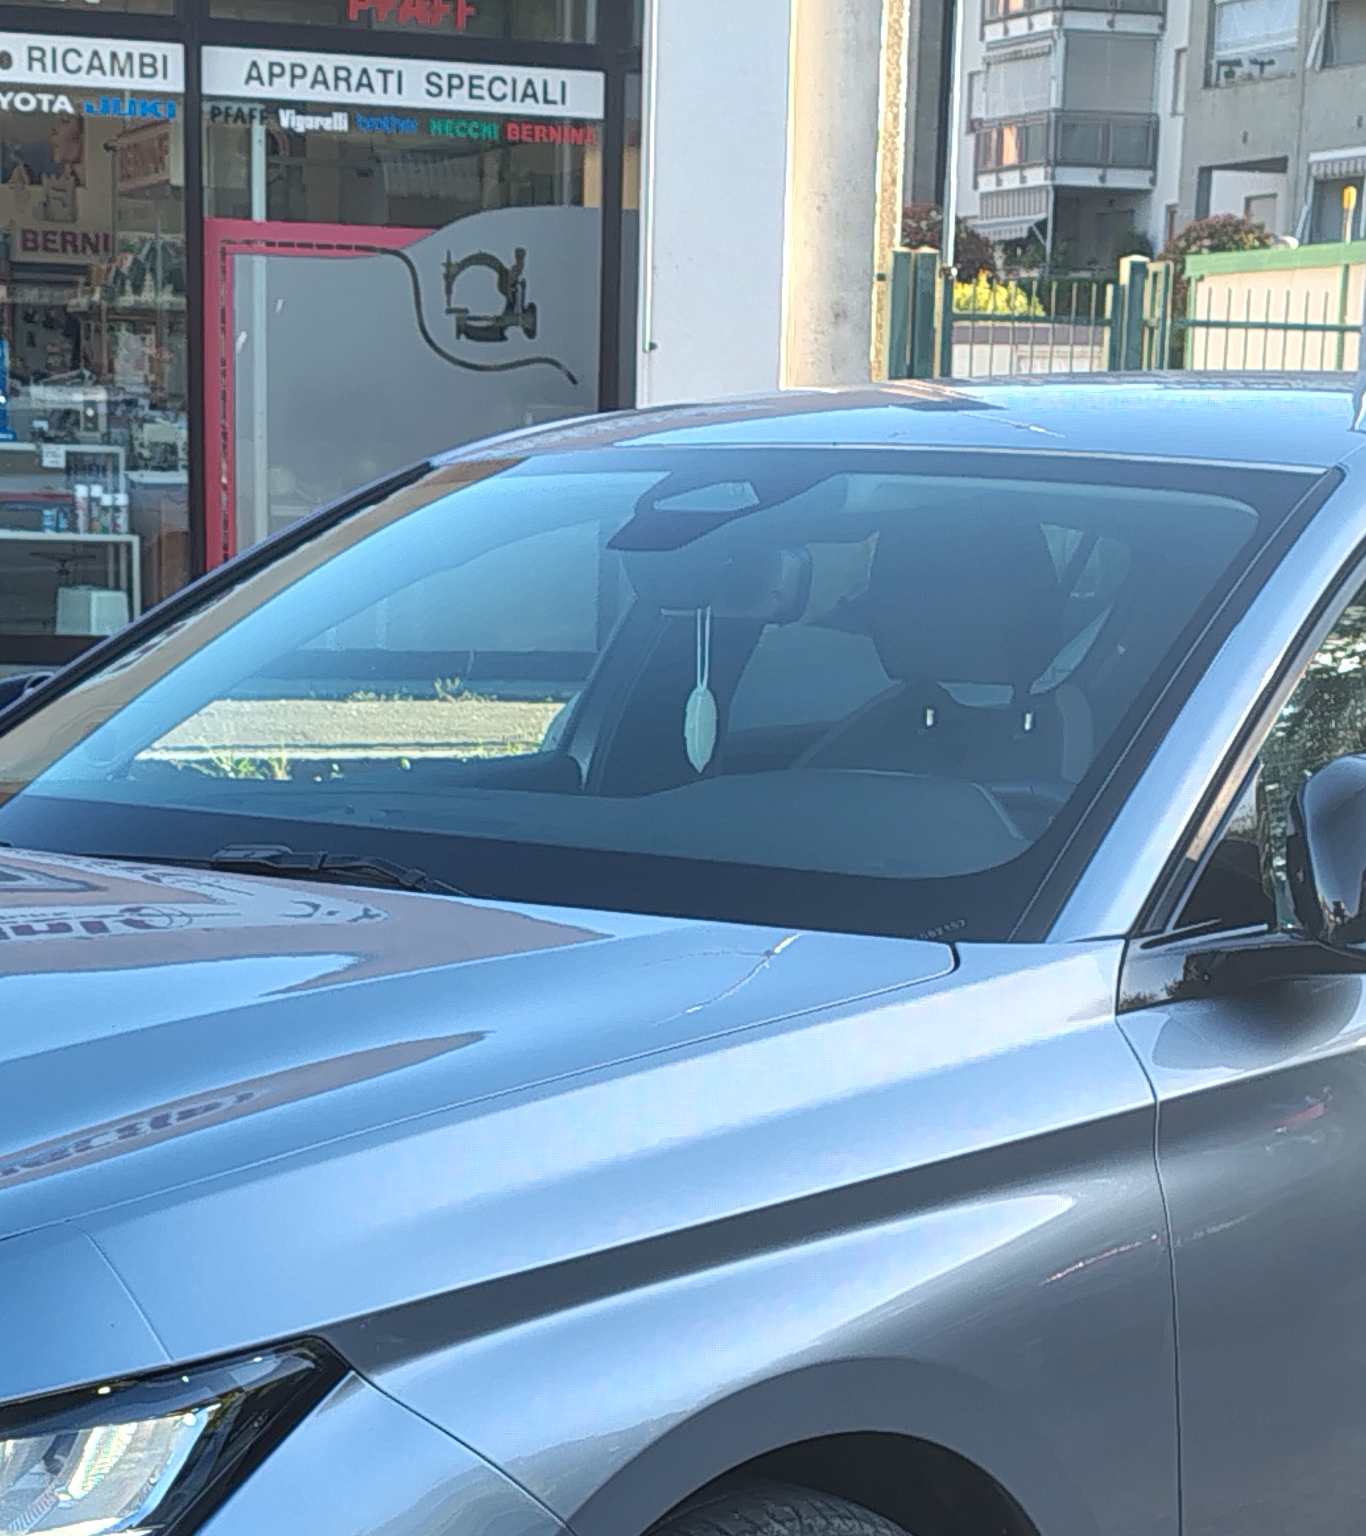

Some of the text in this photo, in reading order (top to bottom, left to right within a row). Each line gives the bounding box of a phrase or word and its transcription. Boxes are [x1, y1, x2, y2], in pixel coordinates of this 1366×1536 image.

[26, 45, 168, 81] RICAMBI
[244, 60, 567, 106] APPARATI SPECIALI
[84, 96, 176, 118] JUKI
[209, 106, 268, 125] PFAFF
